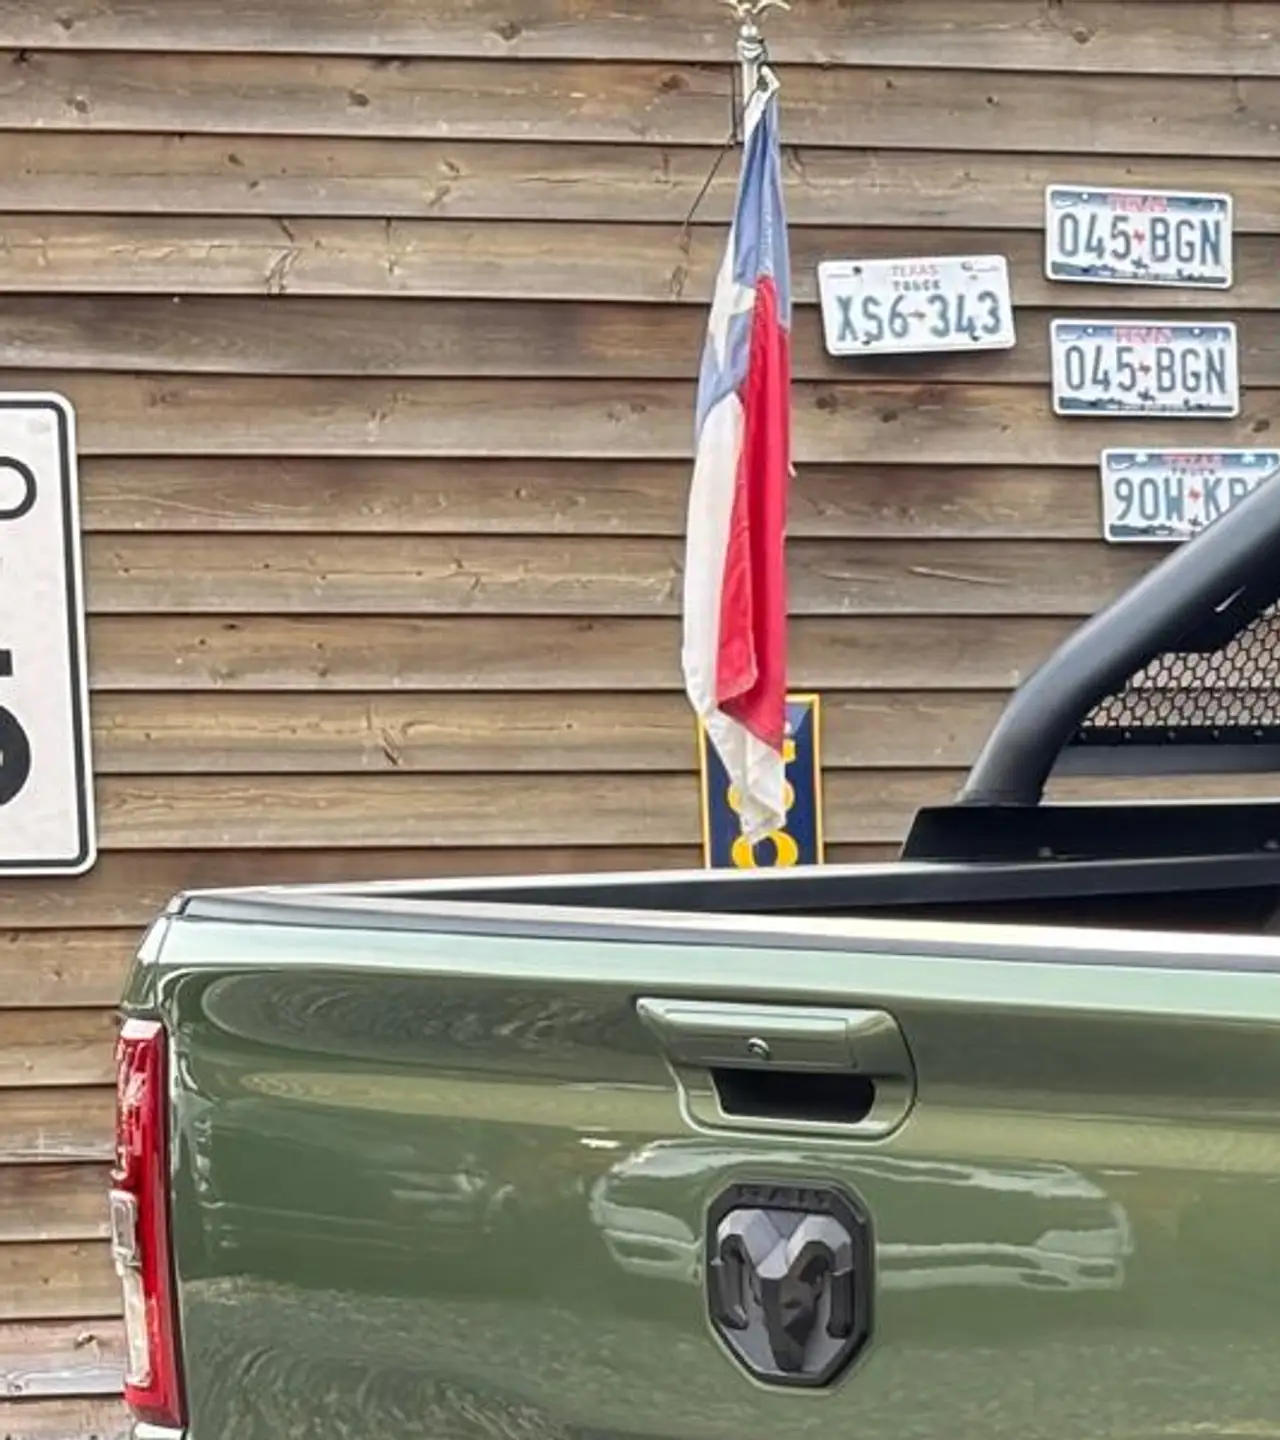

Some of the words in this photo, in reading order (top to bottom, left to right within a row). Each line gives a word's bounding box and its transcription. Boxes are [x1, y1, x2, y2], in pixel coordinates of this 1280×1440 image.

[1150, 216, 1221, 266] BGN
[926, 289, 1001, 338] 343
[1155, 346, 1226, 395] BGN
